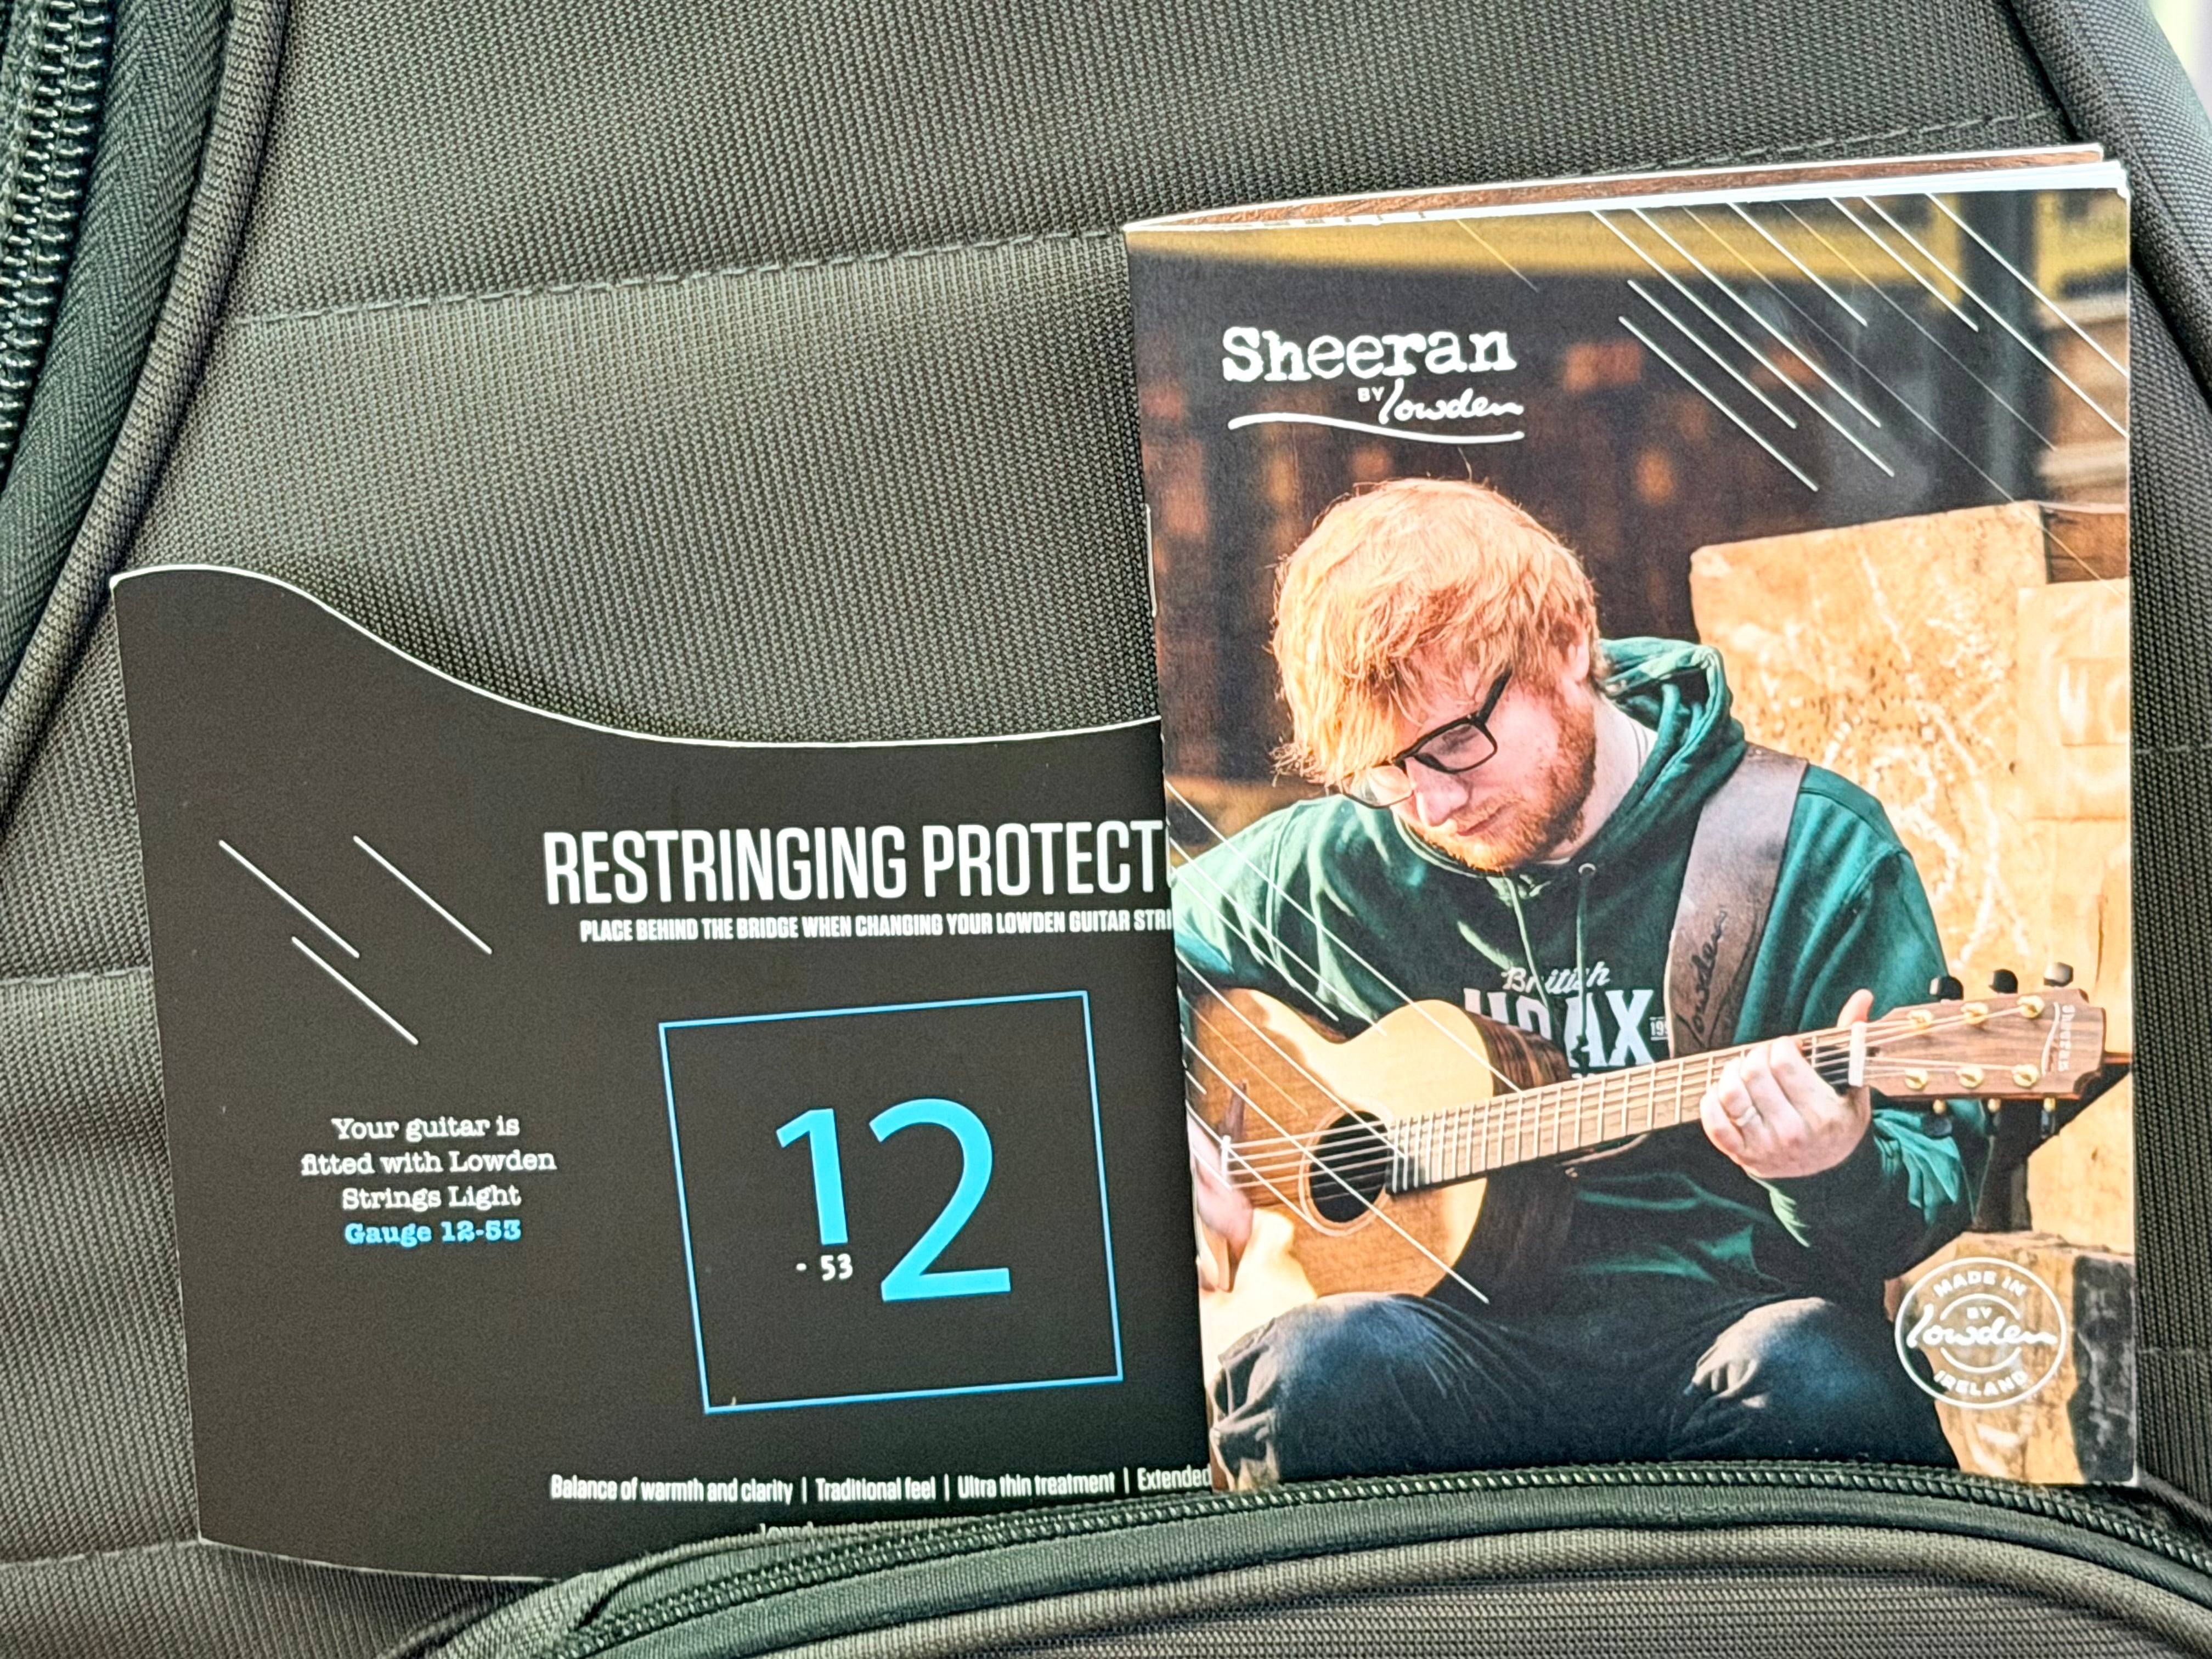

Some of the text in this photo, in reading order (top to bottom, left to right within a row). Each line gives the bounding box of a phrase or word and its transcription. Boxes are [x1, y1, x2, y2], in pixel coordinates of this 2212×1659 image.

[1222, 326, 1517, 381] Sheeran
[1358, 386, 1385, 402] BY
[543, 820, 1163, 905] RESTRINGING PROTECT
[580, 919, 633, 943] PLACE
[636, 918, 698, 941] BEHIND
[701, 918, 733, 940] THE
[737, 917, 799, 939] BRIDGE
[802, 916, 852, 938] WHEN
[855, 913, 943, 937] CHANGING
[946, 912, 994, 935] YOUR
[996, 911, 1066, 934] LOWDEN
[1069, 910, 1131, 933] GUITAR
[330, 1115, 520, 1143] Your guitar is
[300, 1149, 558, 1176] fitted with Lowden
[341, 1184, 522, 1212] Strings Light
[776, 1098, 1011, 1302] 12
[344, 1219, 521, 1249] Gauge 12-53
[1933, 1270, 2029, 1298] MADE IN
[1933, 1369, 2029, 1397] IRELAND
[550, 1474, 618, 1501] Balance
[620, 1476, 638, 1500] of
[640, 1477, 704, 1502] warmth
[707, 1477, 738, 1503] and
[741, 1478, 793, 1505] clarity
[815, 1477, 901, 1502] Traditional
[904, 1476, 936, 1500] feel
[957, 1475, 997, 1499] Ultra
[999, 1474, 1032, 1498] thin
[1034, 1471, 1115, 1497] treatment
[1137, 1463, 1211, 1491] Extended
